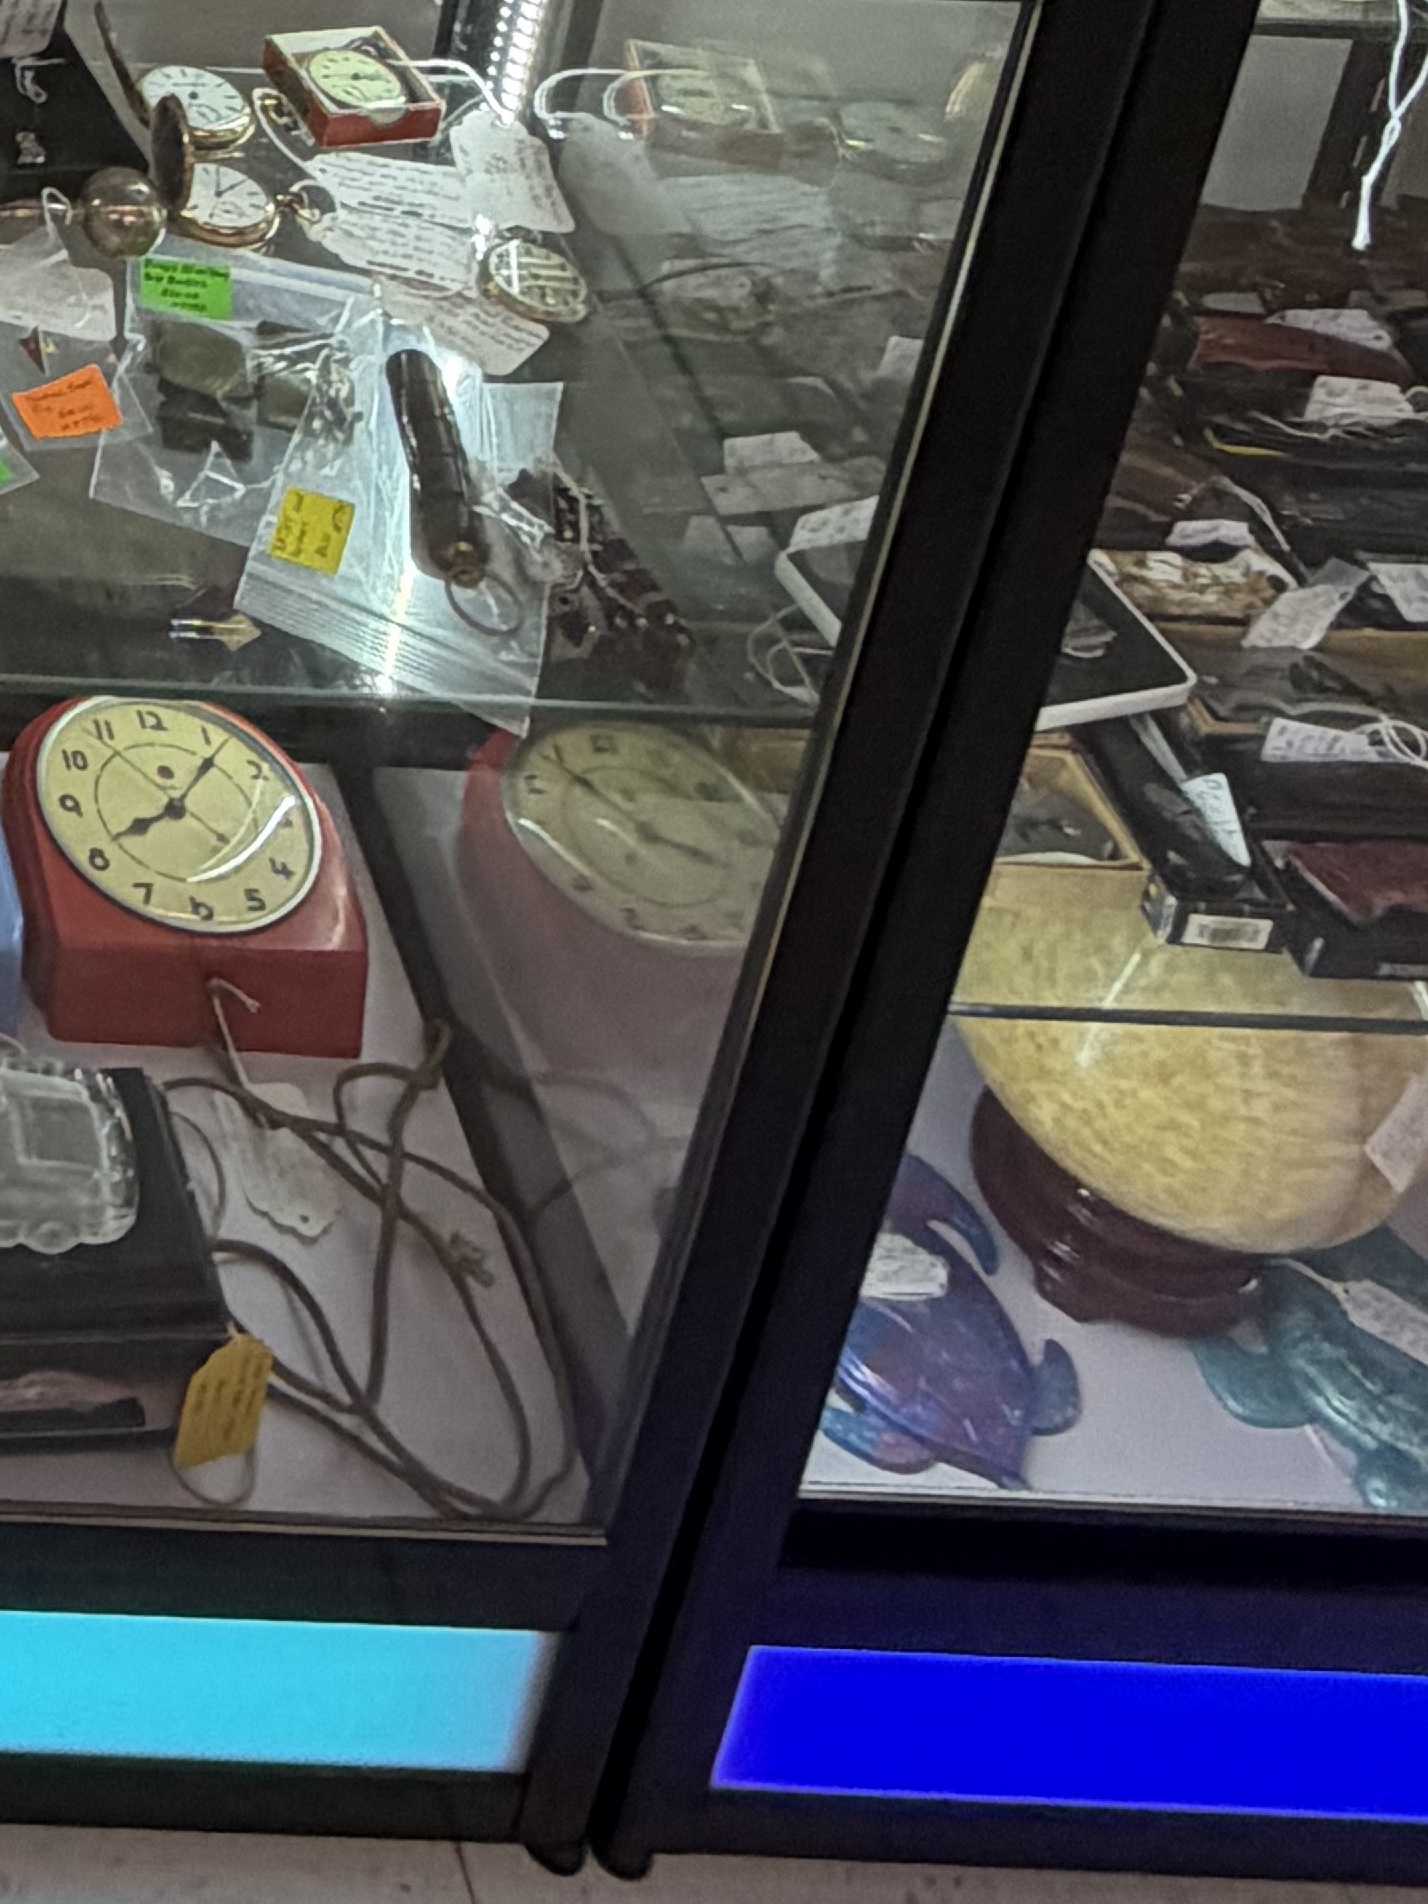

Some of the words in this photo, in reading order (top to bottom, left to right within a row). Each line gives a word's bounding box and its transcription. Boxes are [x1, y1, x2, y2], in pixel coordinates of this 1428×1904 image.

[135, 709, 169, 732] 12
[62, 748, 89, 771] 10
[58, 794, 84, 818] 9
[88, 846, 110, 872] 8
[268, 856, 296, 880] 4
[132, 882, 154, 905] 7
[244, 887, 266, 912] 5
